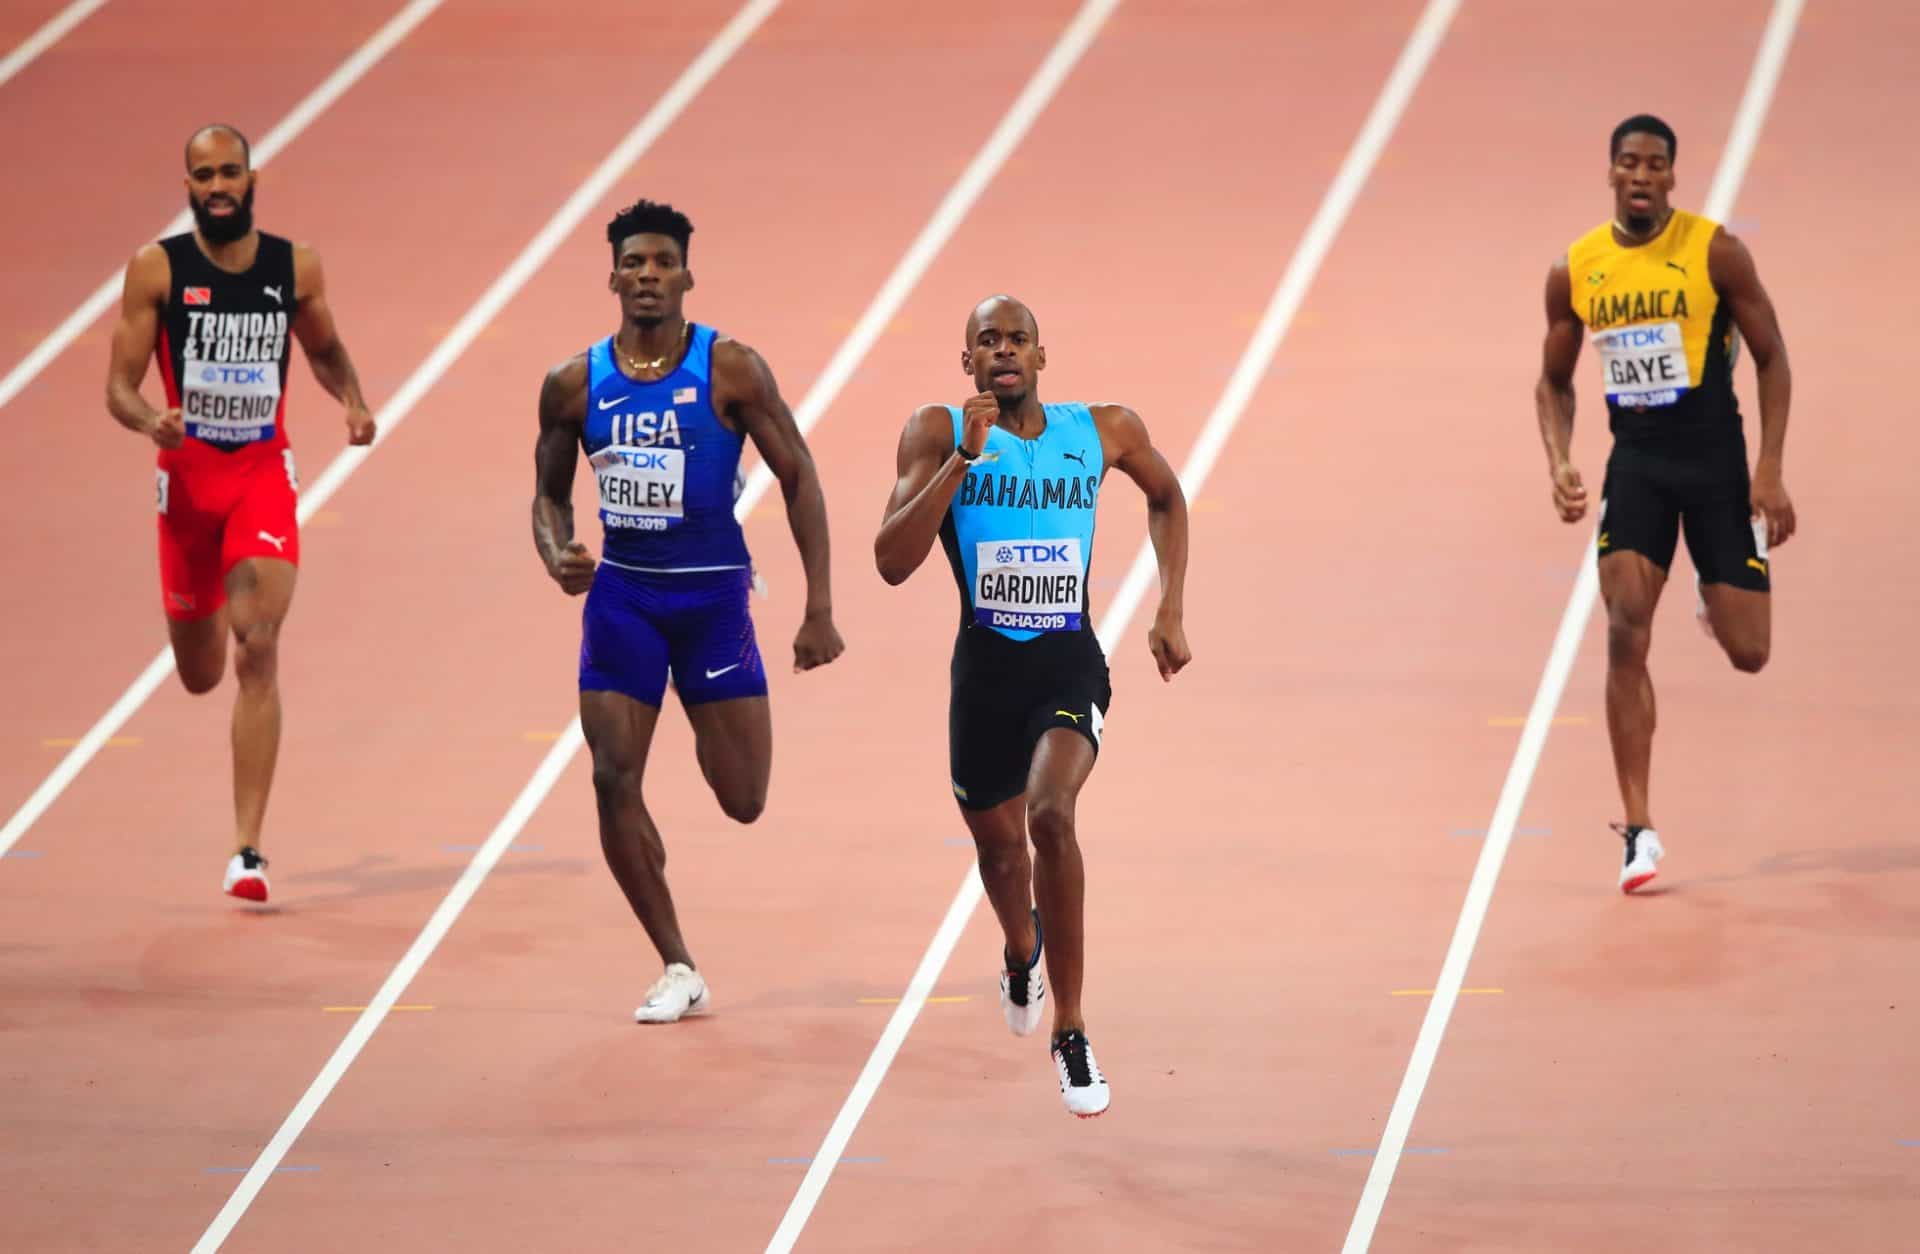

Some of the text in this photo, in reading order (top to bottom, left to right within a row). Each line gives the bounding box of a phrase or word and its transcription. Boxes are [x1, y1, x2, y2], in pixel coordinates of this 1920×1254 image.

[1589, 289, 1688, 326] JAMAICA
[187, 311, 287, 340] TRINIDAD
[1621, 327, 1665, 347] TDK
[218, 367, 264, 383] TDK
[1610, 354, 1676, 385] GAYE
[186, 391, 273, 420] CEDENIO
[611, 409, 681, 447] USA
[616, 450, 669, 471] TDK
[599, 473, 676, 509] KERLEY
[960, 472, 1097, 510] BAHAMAS
[1013, 544, 1069, 562] TDK
[980, 573, 1078, 606] GARDINER
[992, 611, 1066, 629] DOHA2019
